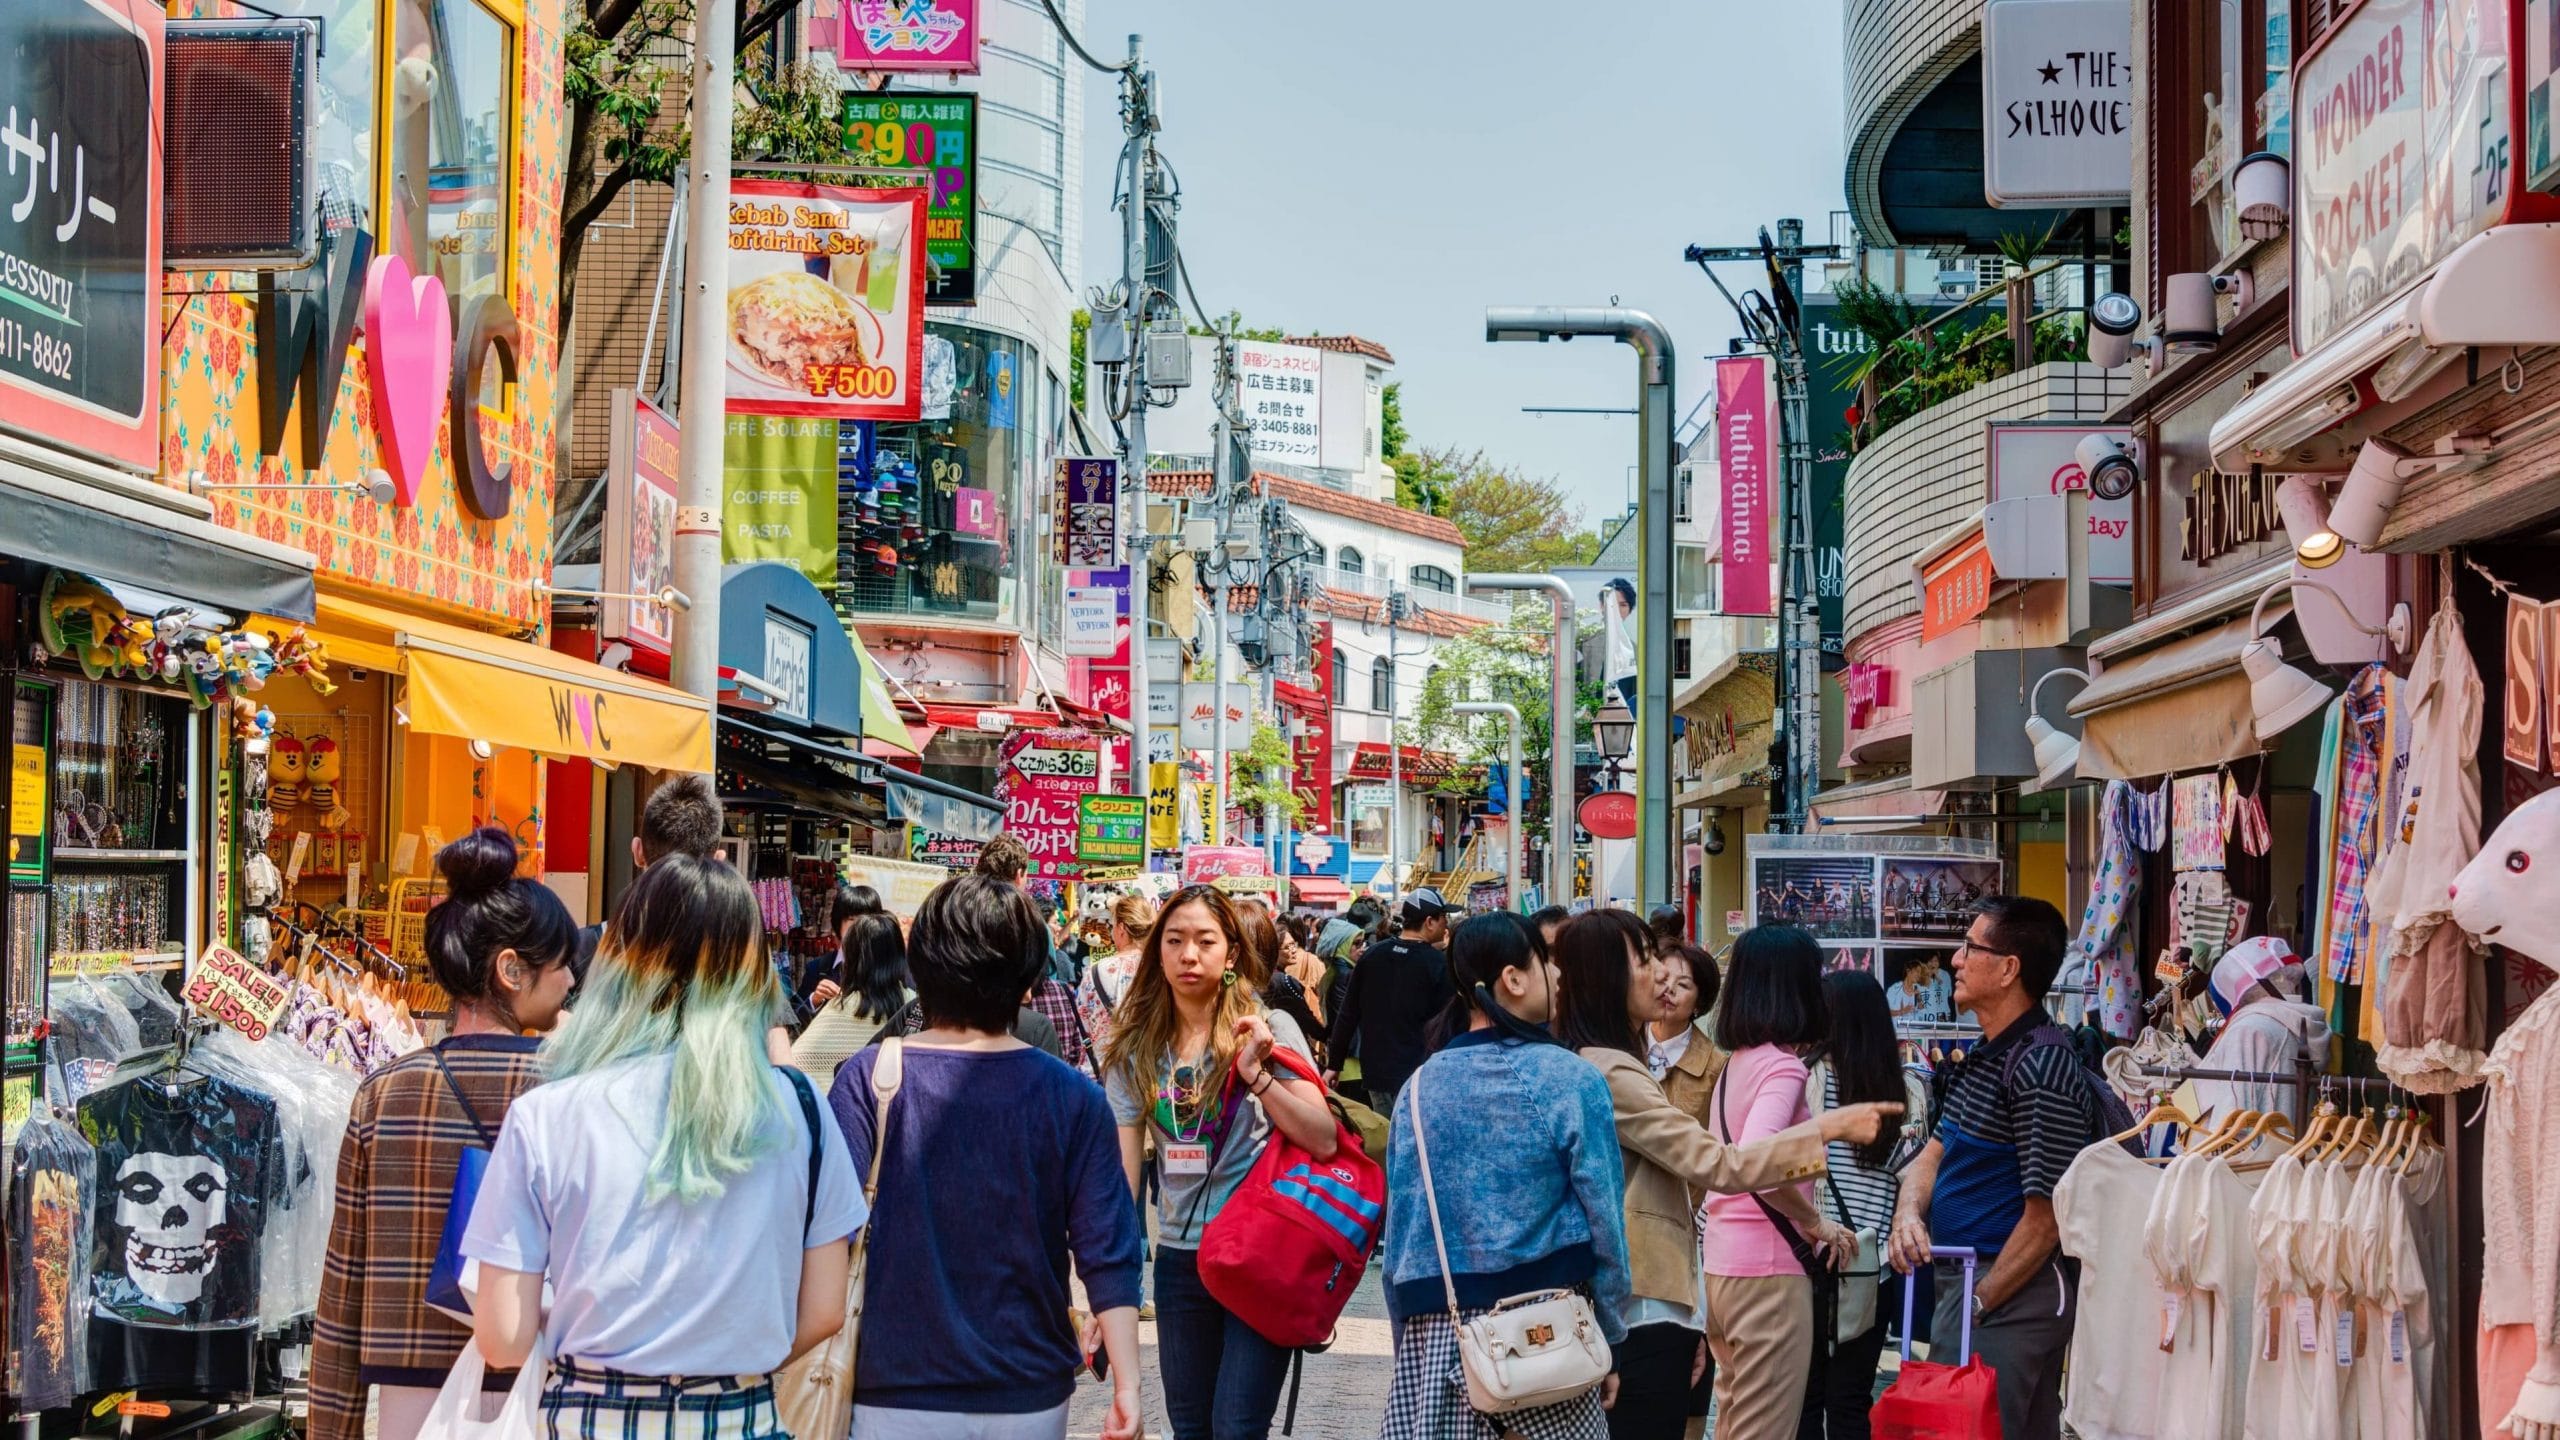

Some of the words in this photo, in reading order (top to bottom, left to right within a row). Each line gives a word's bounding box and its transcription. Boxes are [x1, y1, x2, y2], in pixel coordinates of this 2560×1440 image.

[2066, 51, 2117, 90] THE
[2313, 24, 2405, 171] WONDER
[2006, 99, 2131, 138] SiLHOUE
[847, 122, 965, 166] 390円
[2485, 136, 2508, 205] 2F
[794, 205, 850, 229] Sand
[2314, 140, 2406, 281] ROCKET
[728, 228, 823, 254] oftdrink
[827, 231, 865, 255] Set
[0, 251, 73, 319] essory
[804, 363, 896, 398] ¥500
[1247, 373, 1316, 395] 広告主募集
[1257, 401, 1306, 418] お問合せ
[724, 419, 757, 437] FFÈ
[732, 490, 801, 506] COFFEE
[1081, 462, 1102, 561] パワーストーン
[700, 512, 709, 523] 3
[738, 523, 793, 539] PASTA
[548, 685, 572, 747] W
[594, 692, 611, 752] C
[1018, 752, 1096, 775] ここから36歩
[1188, 857, 1226, 881] joli
[188, 974, 267, 1041] ¥1500
